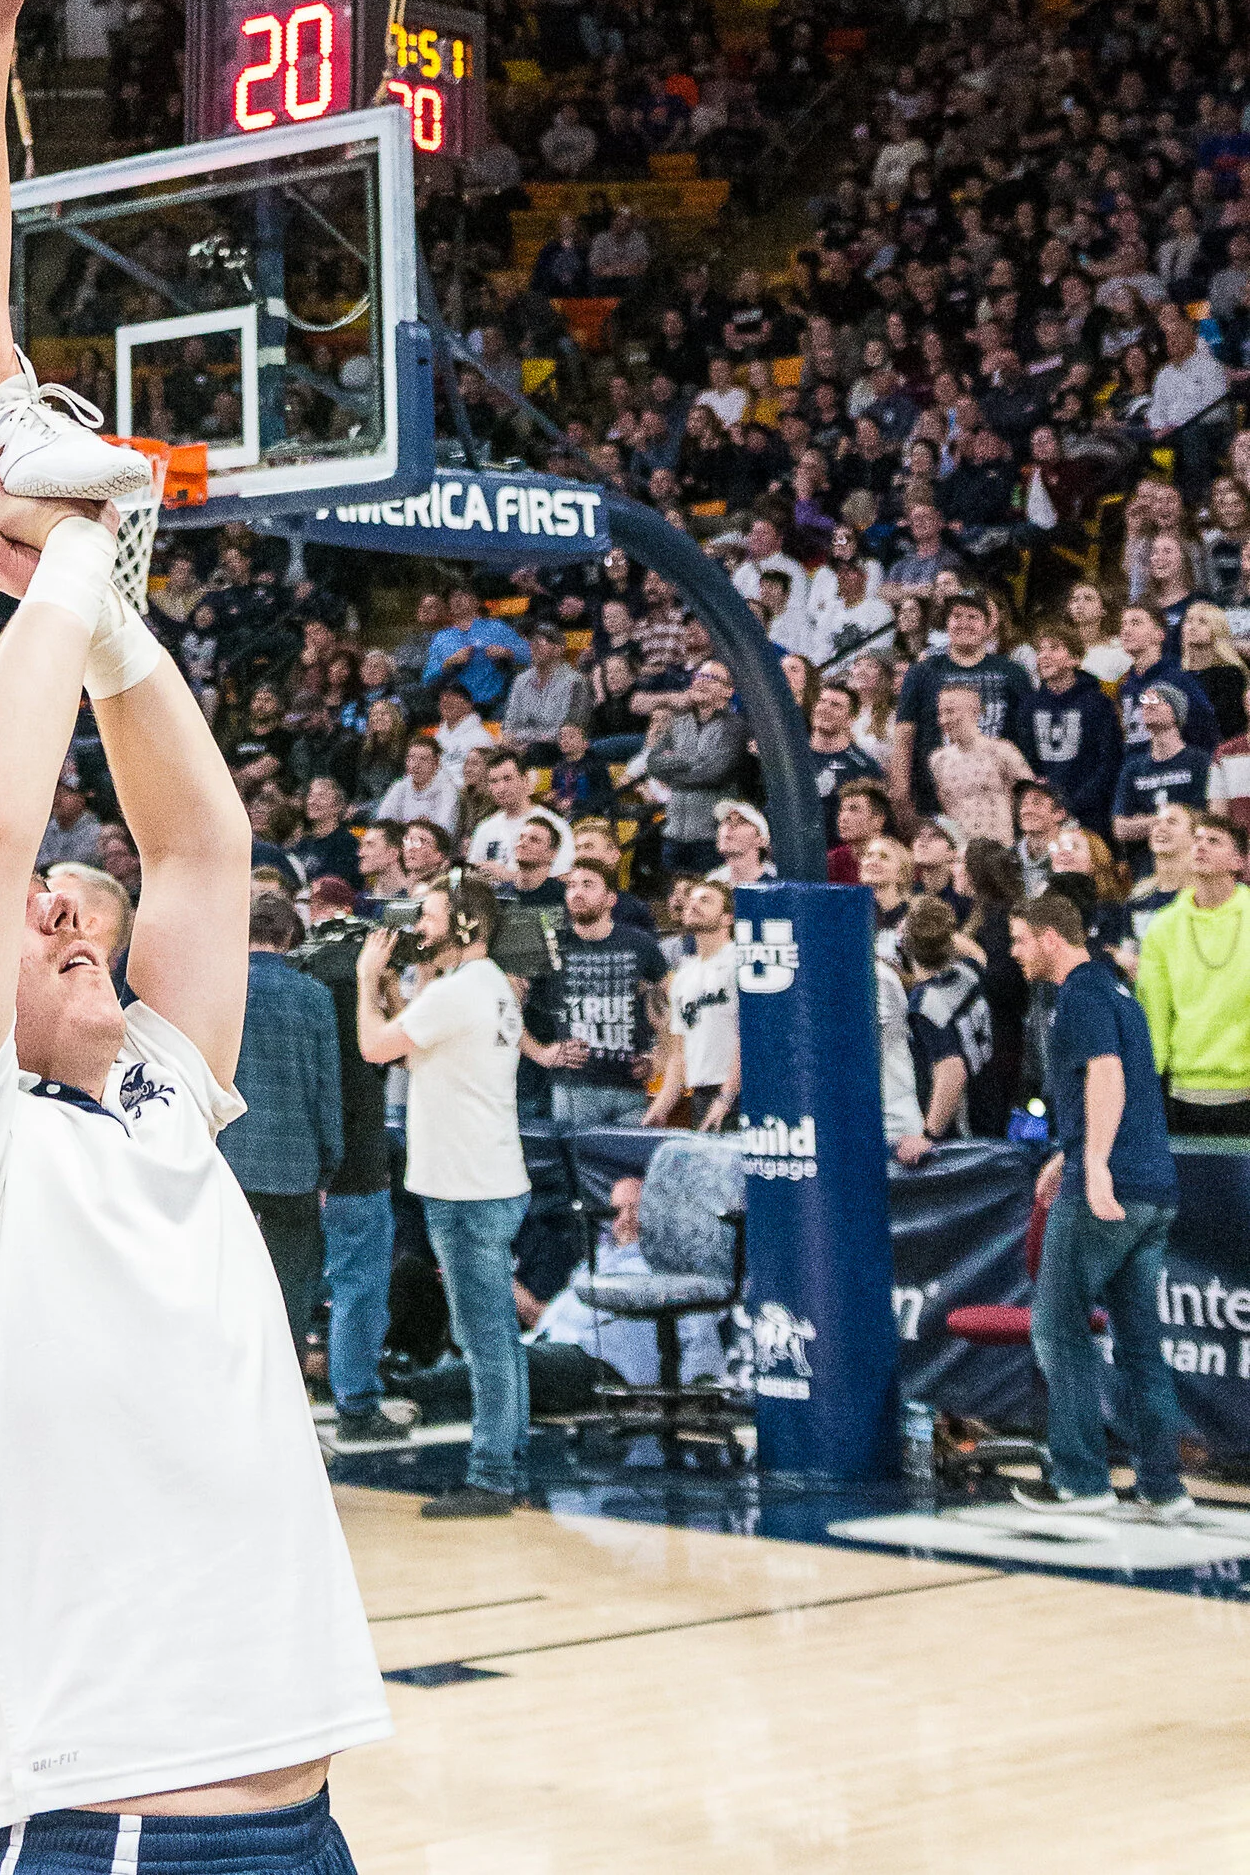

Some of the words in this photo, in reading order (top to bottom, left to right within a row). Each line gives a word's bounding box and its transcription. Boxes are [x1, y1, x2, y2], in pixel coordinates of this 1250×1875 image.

[234, 1, 333, 131] 20
[390, 23, 464, 79] 7:51
[316, 481, 493, 532] ERICA
[496, 485, 602, 538] FIRST
[562, 995, 636, 1024] TRUE
[736, 1113, 817, 1158] uild
[32, 1749, 79, 1773] DRI-FIT
